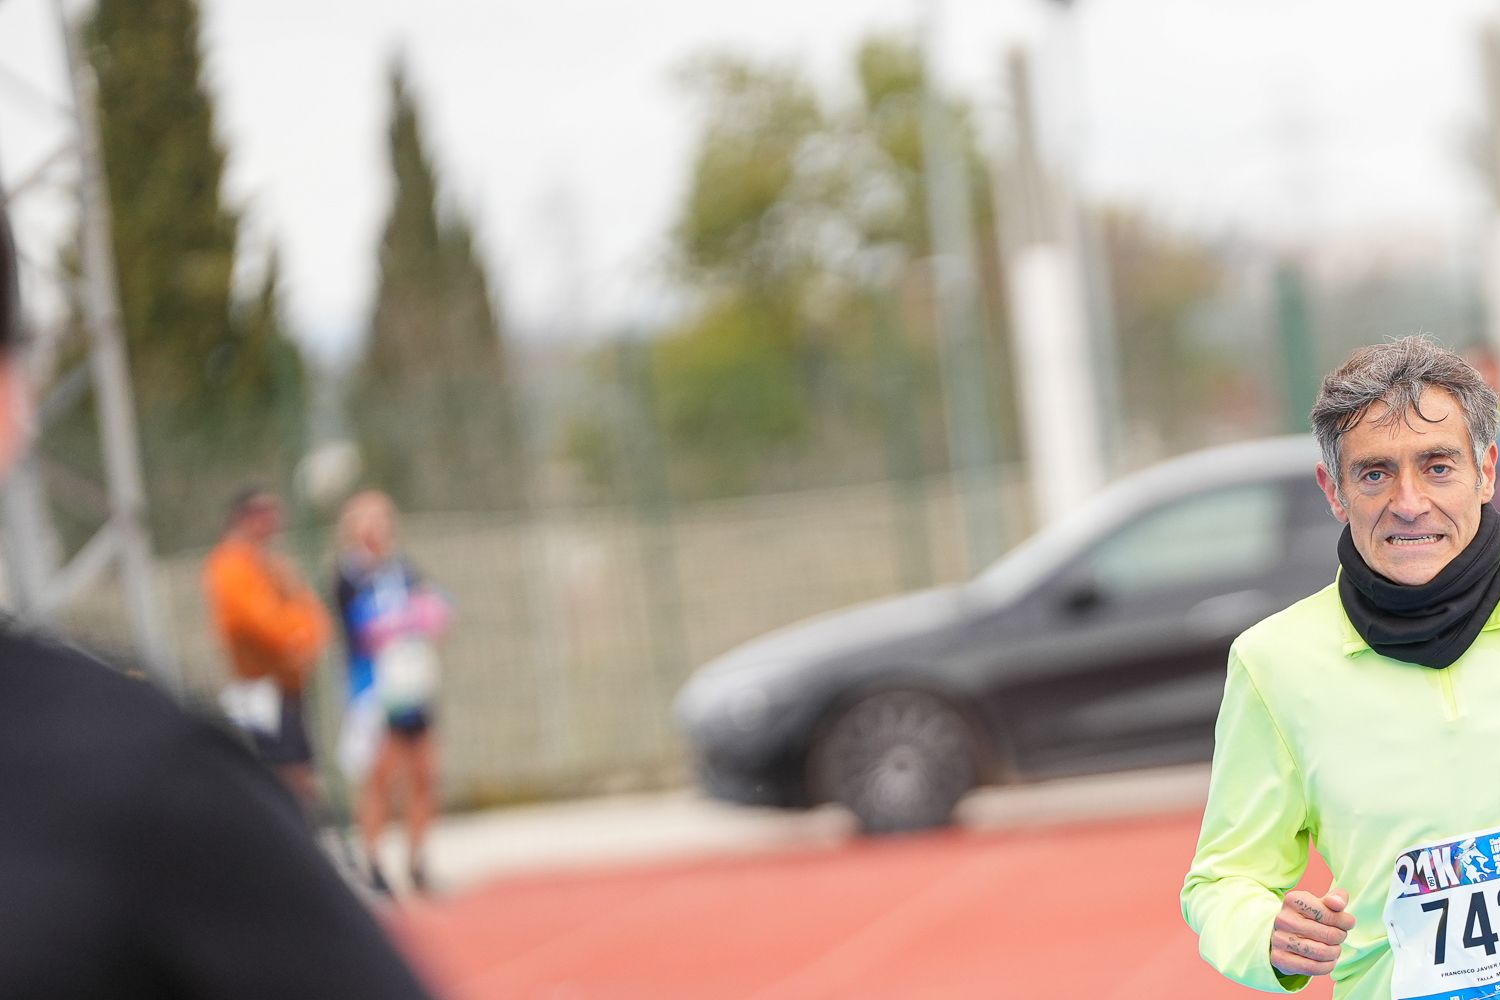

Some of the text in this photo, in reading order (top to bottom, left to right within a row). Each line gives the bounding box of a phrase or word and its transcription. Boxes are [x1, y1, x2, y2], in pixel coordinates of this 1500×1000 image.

[1395, 847, 1460, 895] 21K
[1441, 968, 1475, 978] FRANCISCO
[1476, 964, 1498, 973] JAVIER
